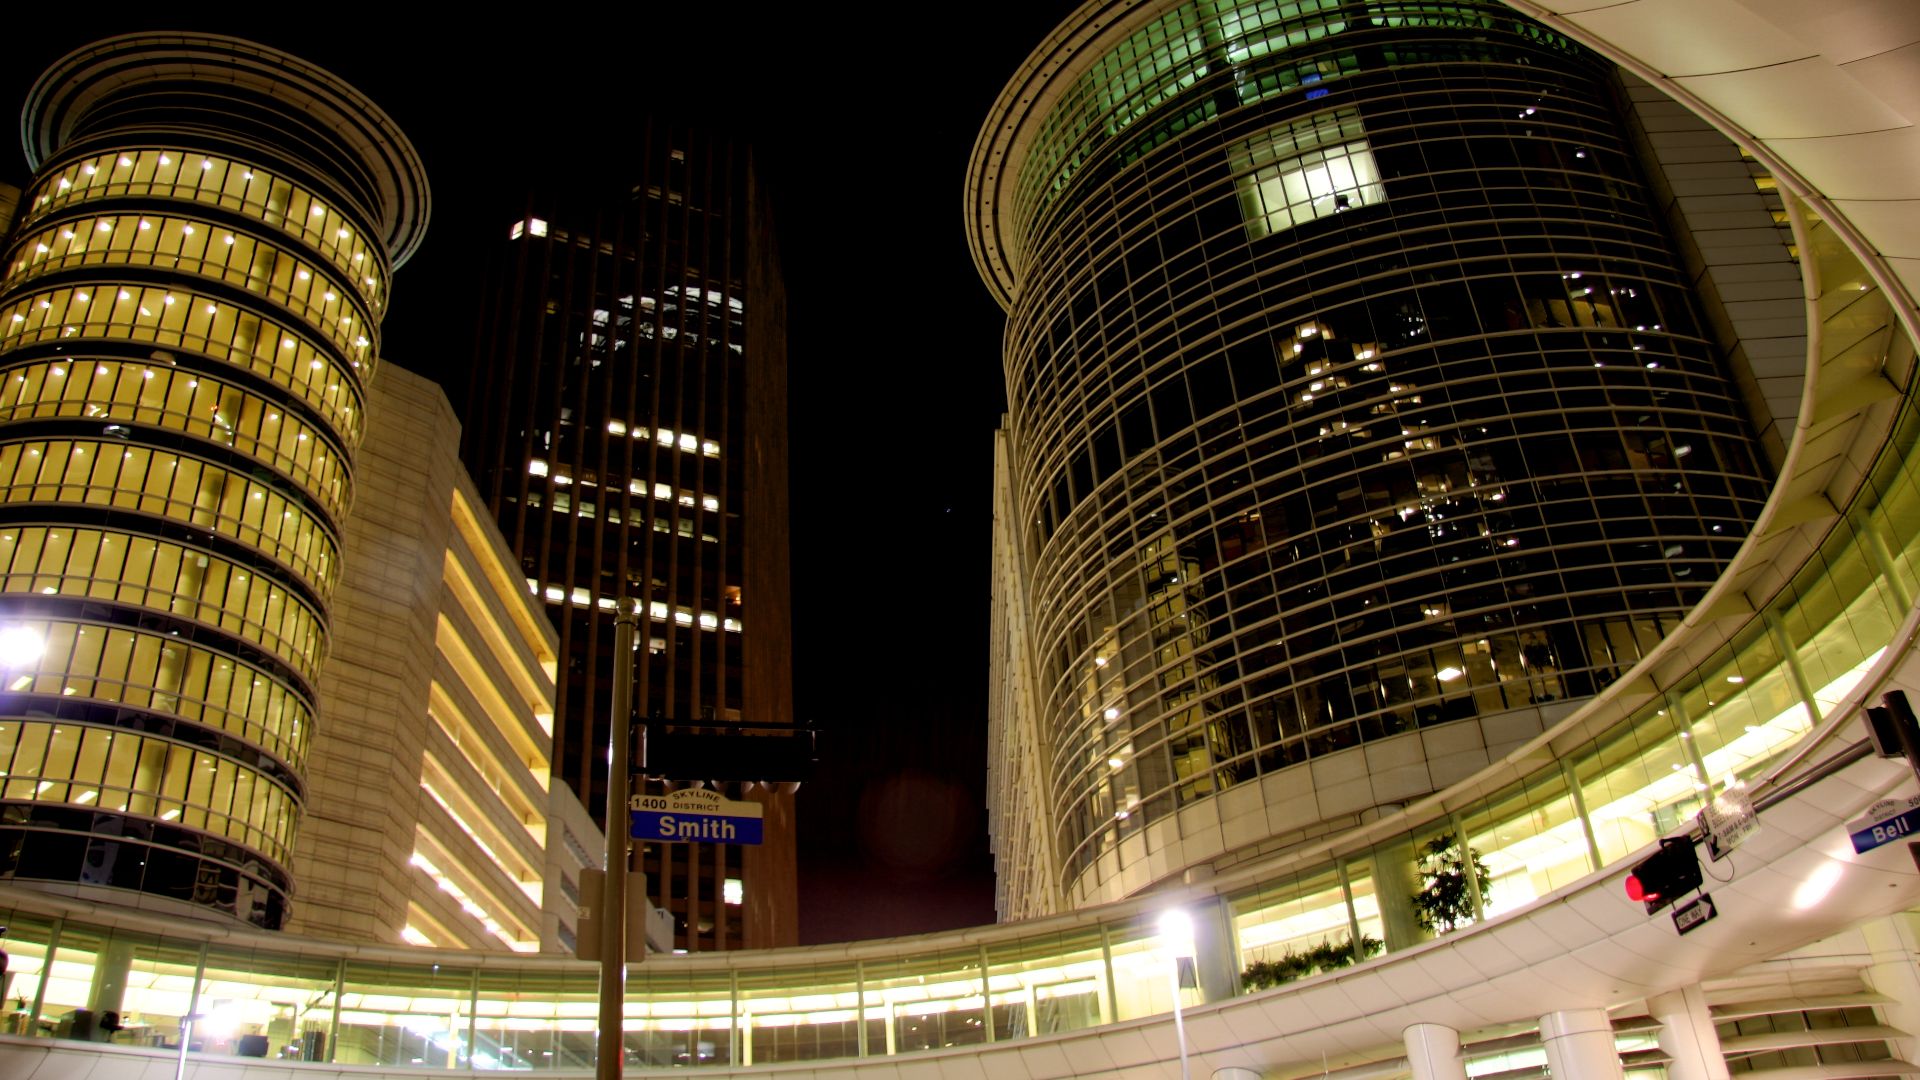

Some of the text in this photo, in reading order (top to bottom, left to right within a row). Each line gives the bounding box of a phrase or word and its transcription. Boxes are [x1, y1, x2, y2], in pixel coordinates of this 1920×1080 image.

[672, 790, 720, 803] SKYLINE
[1908, 794, 1920, 807] 50
[634, 798, 667, 809] 1400
[672, 801, 720, 811] DISTRICT
[659, 815, 736, 839] Smith
[1871, 816, 1910, 843] Bell
